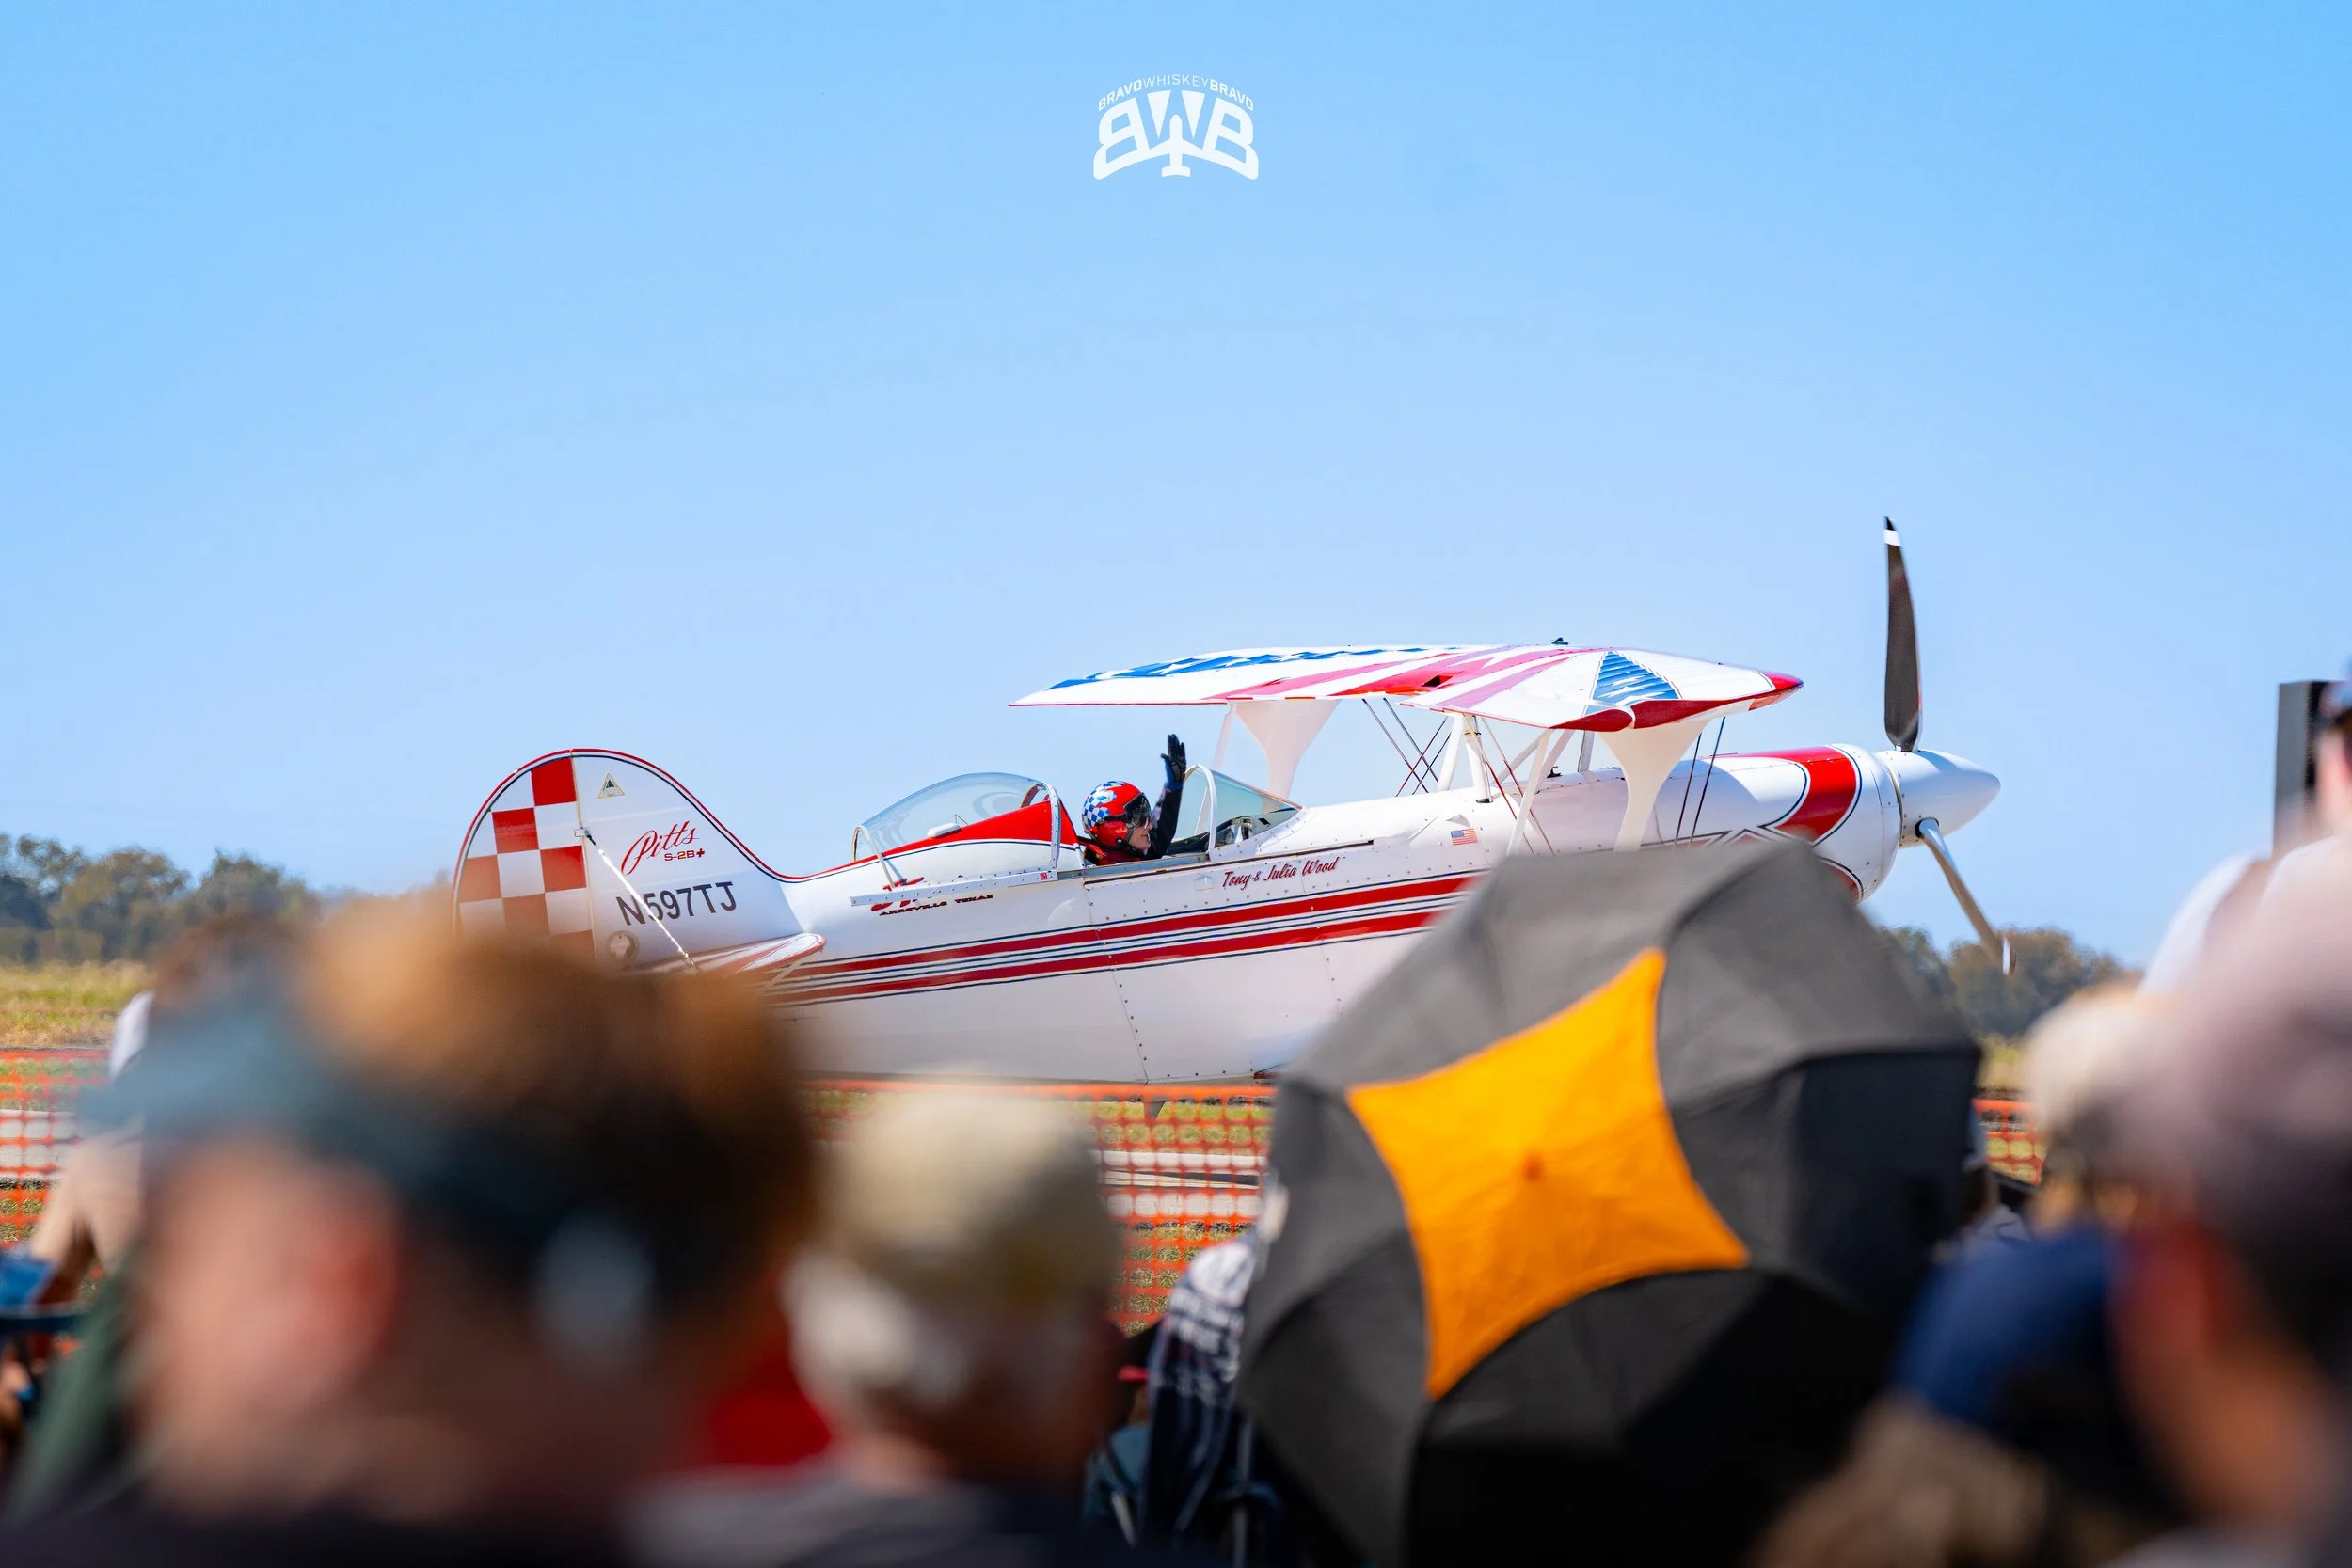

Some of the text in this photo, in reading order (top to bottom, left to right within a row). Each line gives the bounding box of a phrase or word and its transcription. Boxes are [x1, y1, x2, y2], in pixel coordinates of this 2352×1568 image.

[621, 820, 700, 876] Pitts
[1222, 871, 1252, 891] Tony
[1263, 863, 1297, 882] Julia
[1301, 856, 1340, 877] Wood
[616, 881, 737, 926] N597TJ
